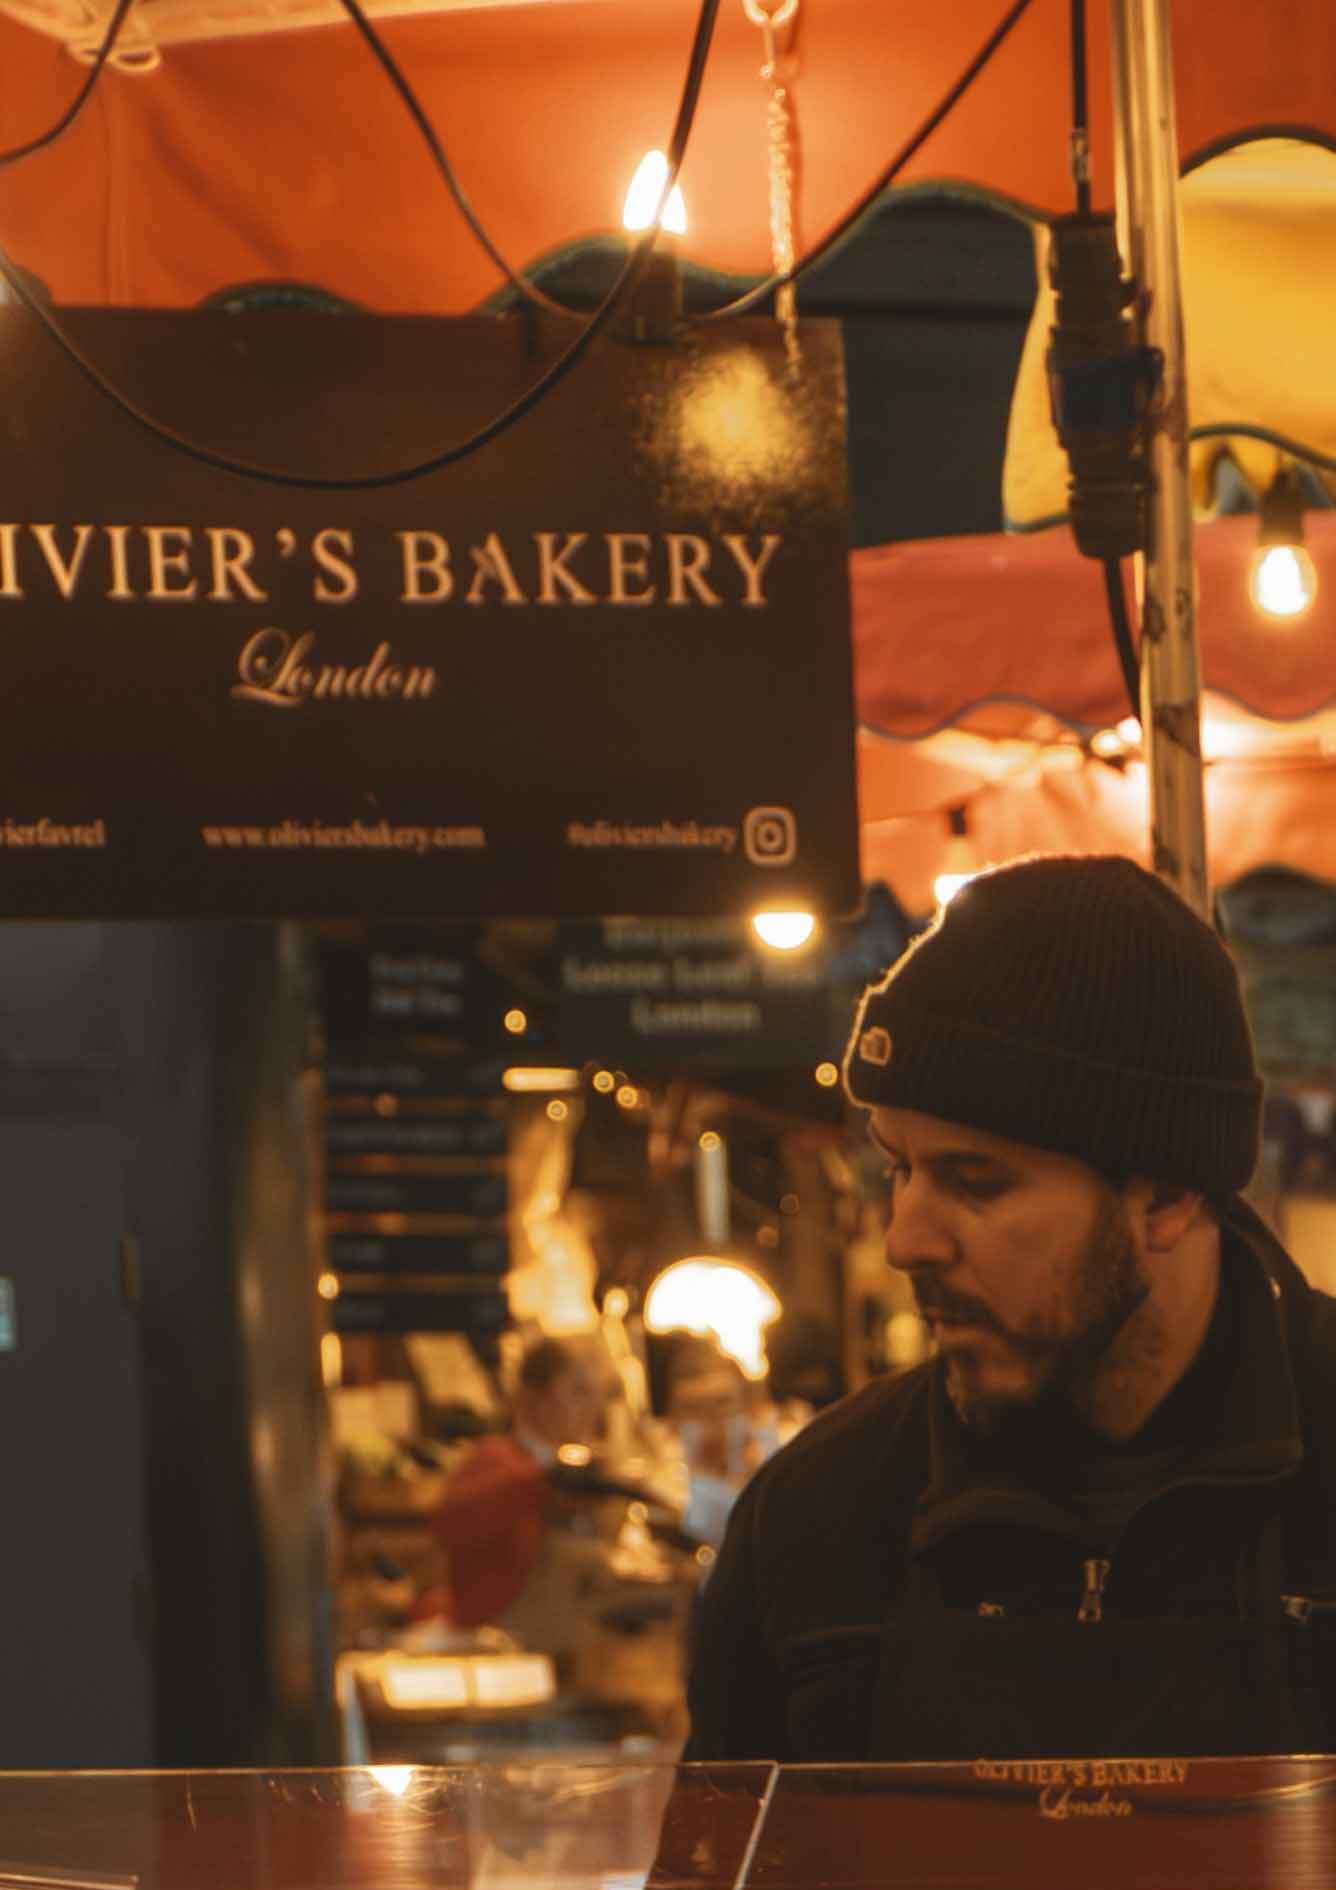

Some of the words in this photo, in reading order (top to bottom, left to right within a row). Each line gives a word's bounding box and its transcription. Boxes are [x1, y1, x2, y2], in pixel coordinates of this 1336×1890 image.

[396, 530, 782, 607] BAKERY
[230, 627, 437, 706] London
[0, 817, 105, 848] ierfavrel
